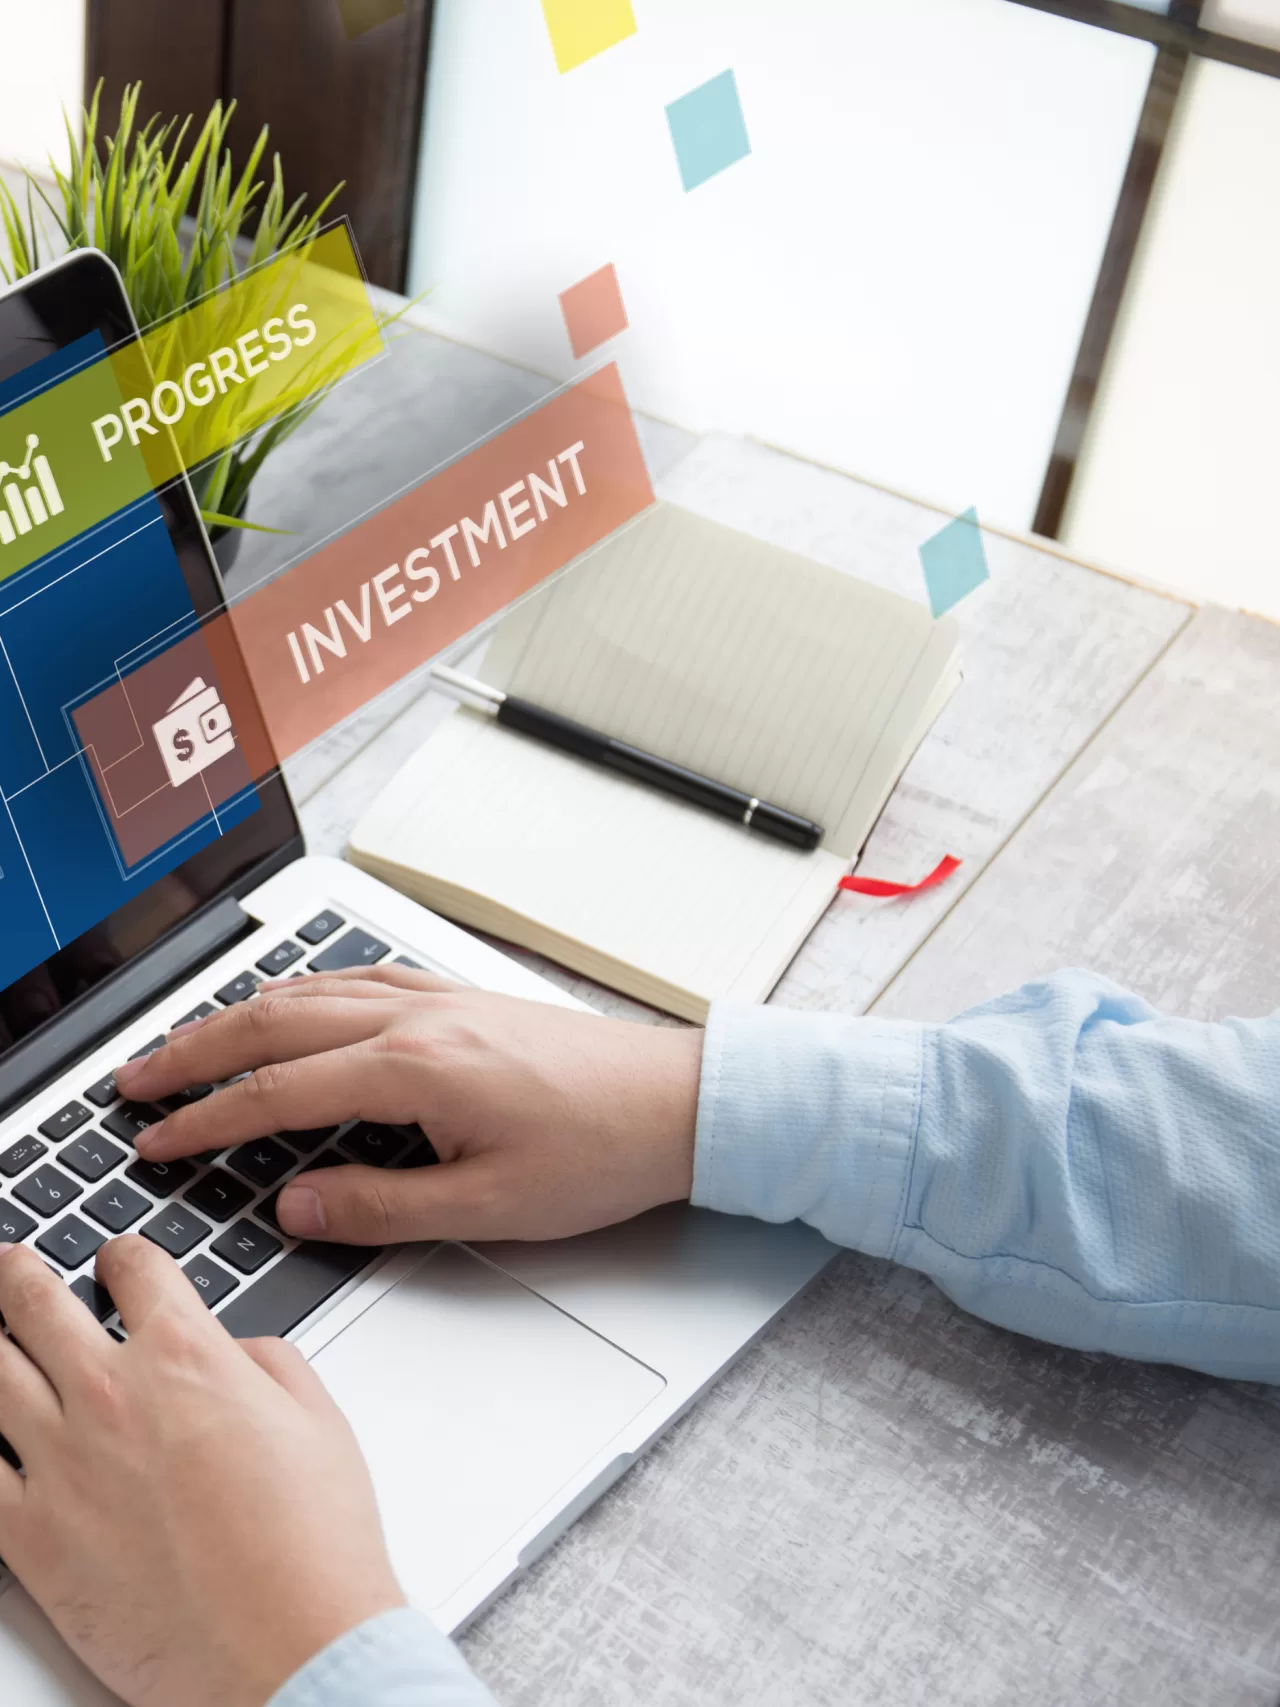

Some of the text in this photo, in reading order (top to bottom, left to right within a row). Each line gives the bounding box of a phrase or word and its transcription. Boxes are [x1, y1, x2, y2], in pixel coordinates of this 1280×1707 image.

[78, 1107, 88, 1117] F7
[31, 1143, 43, 1153] F6
[91, 1153, 104, 1165] 7
[254, 1151, 271, 1165] K
[153, 1161, 169, 1176] U
[49, 1188, 61, 1199] 6
[215, 1187, 227, 1199] J
[108, 1197, 124, 1209] Y
[2, 1223, 16, 1235] 5
[166, 1220, 185, 1235] H
[63, 1232, 78, 1245] T
[236, 1237, 255, 1252] N
[194, 1274, 210, 1288] B
